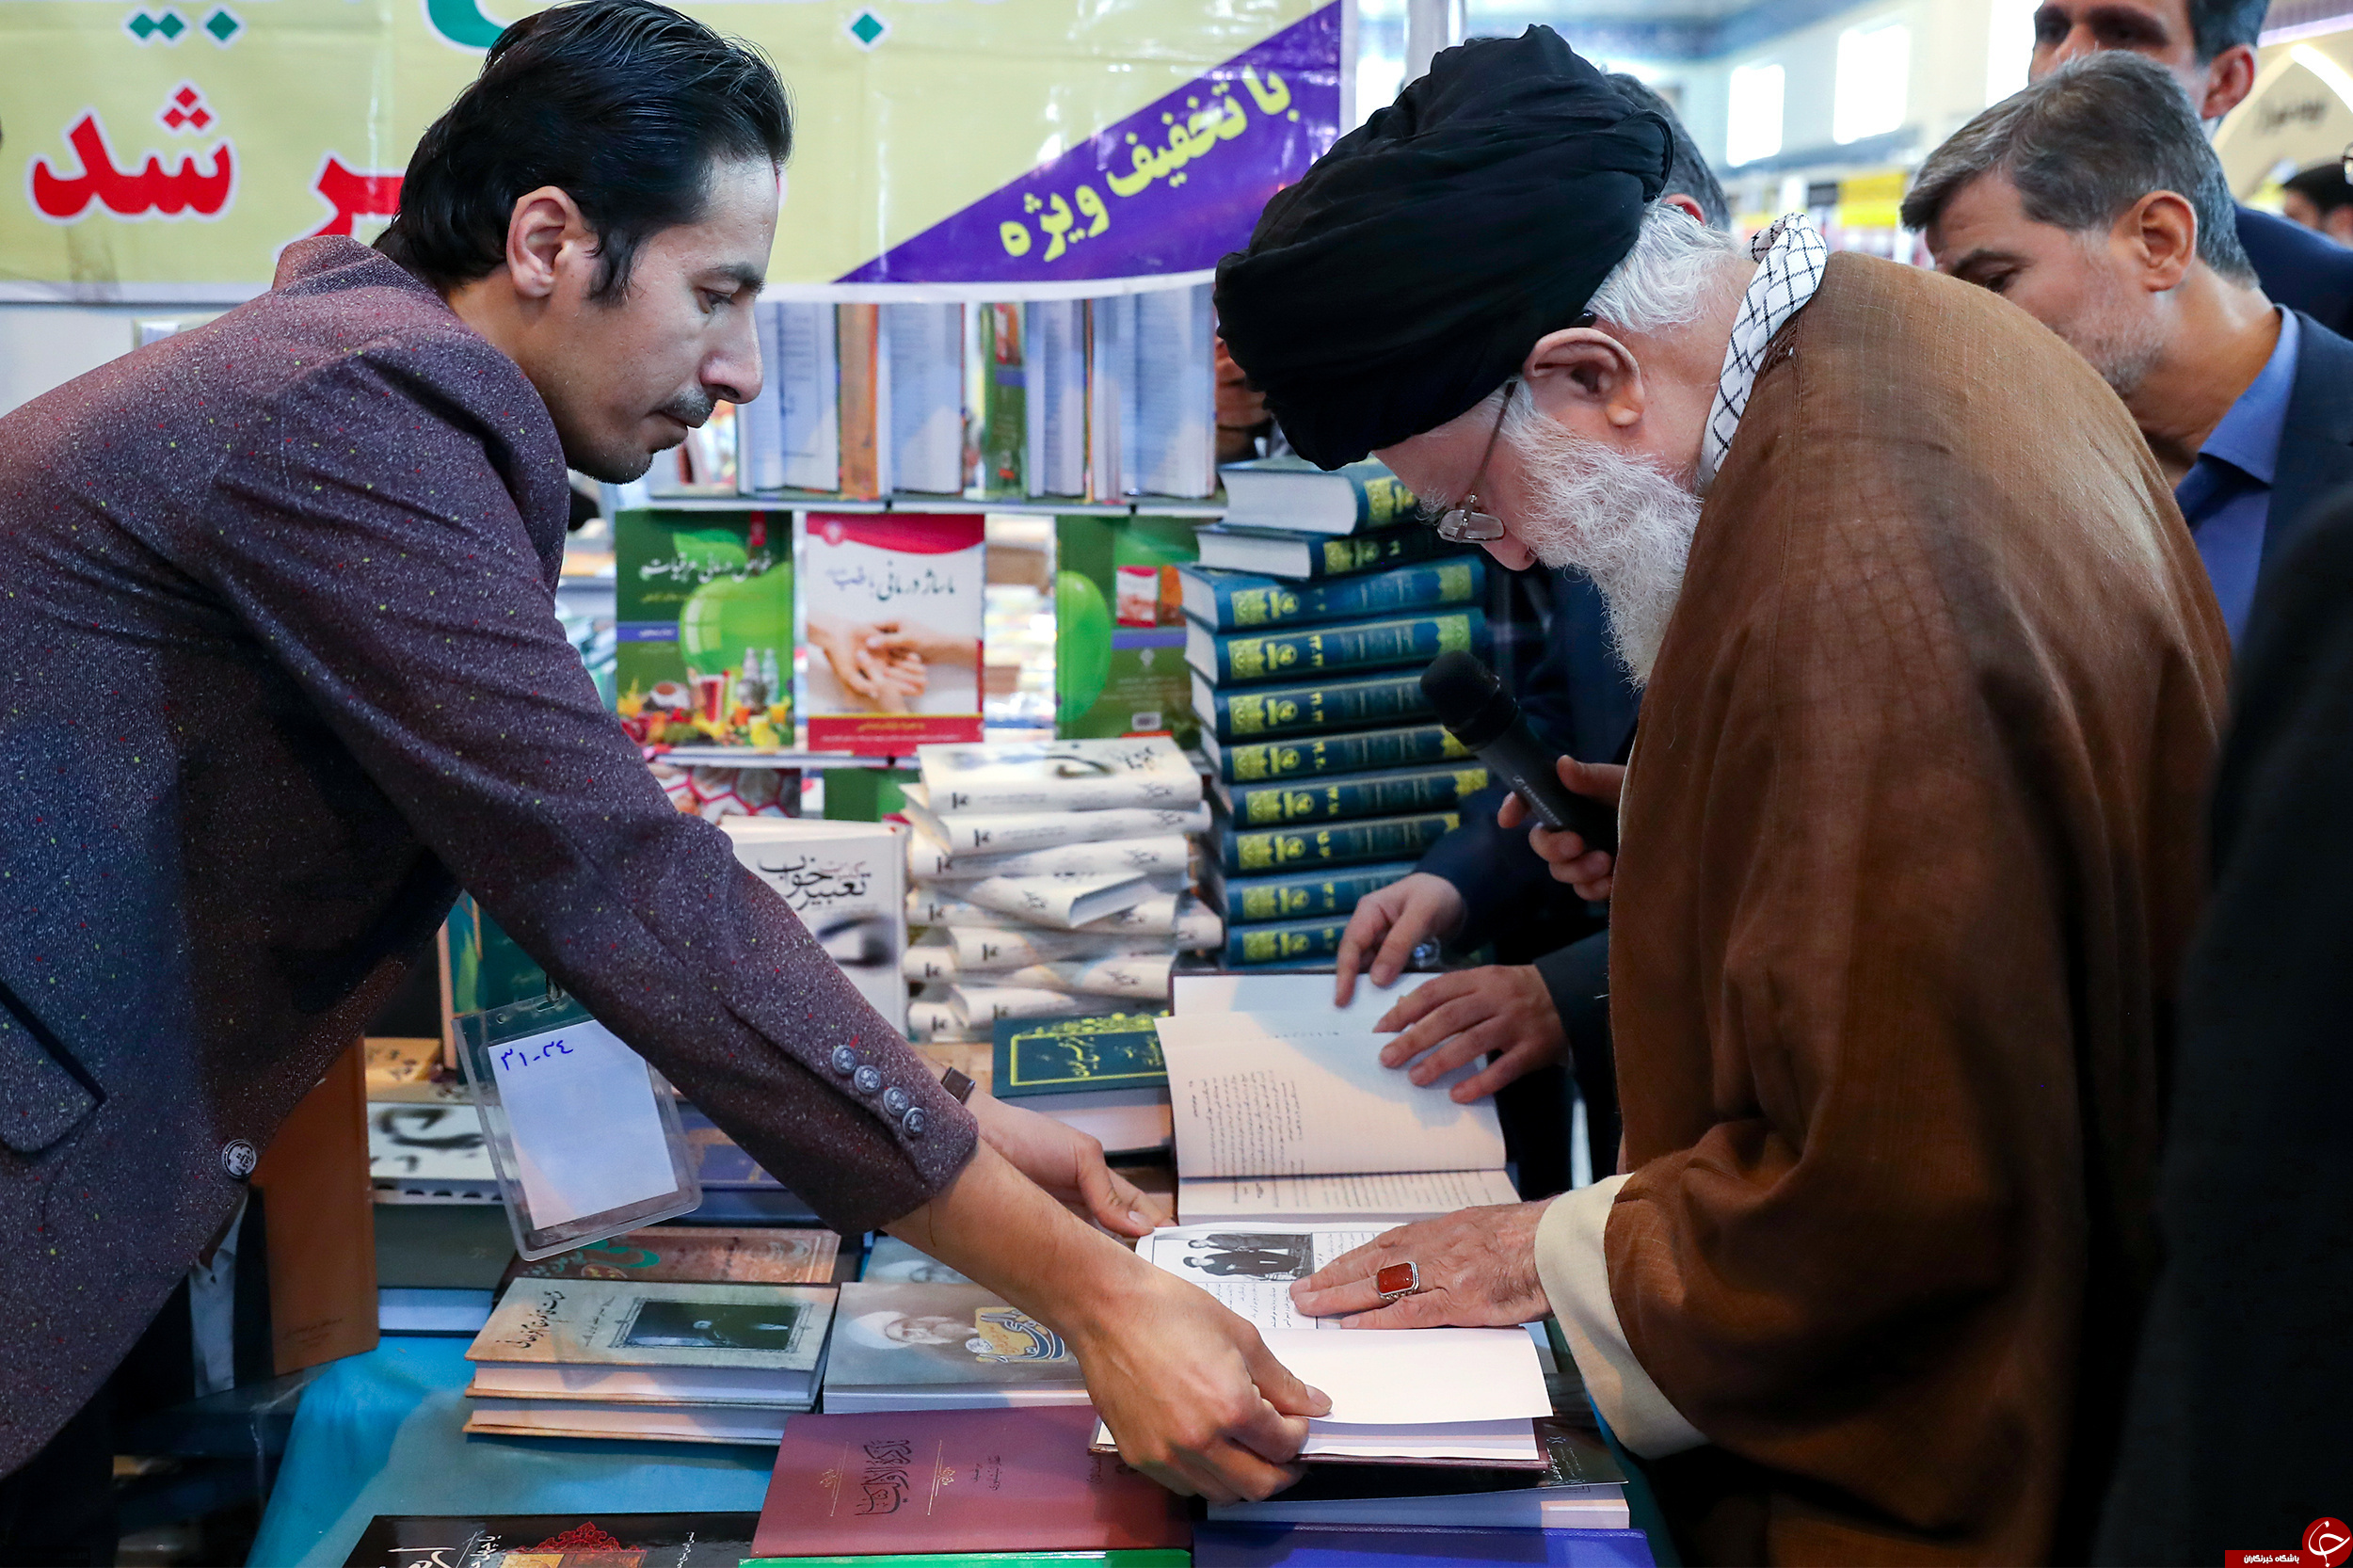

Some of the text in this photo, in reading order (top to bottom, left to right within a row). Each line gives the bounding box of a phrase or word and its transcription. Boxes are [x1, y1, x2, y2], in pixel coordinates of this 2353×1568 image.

[32, 86, 233, 216] شد
[999, 64, 1300, 263] با تخفیف ویژه
[758, 855, 872, 911] تعبیر خواب
